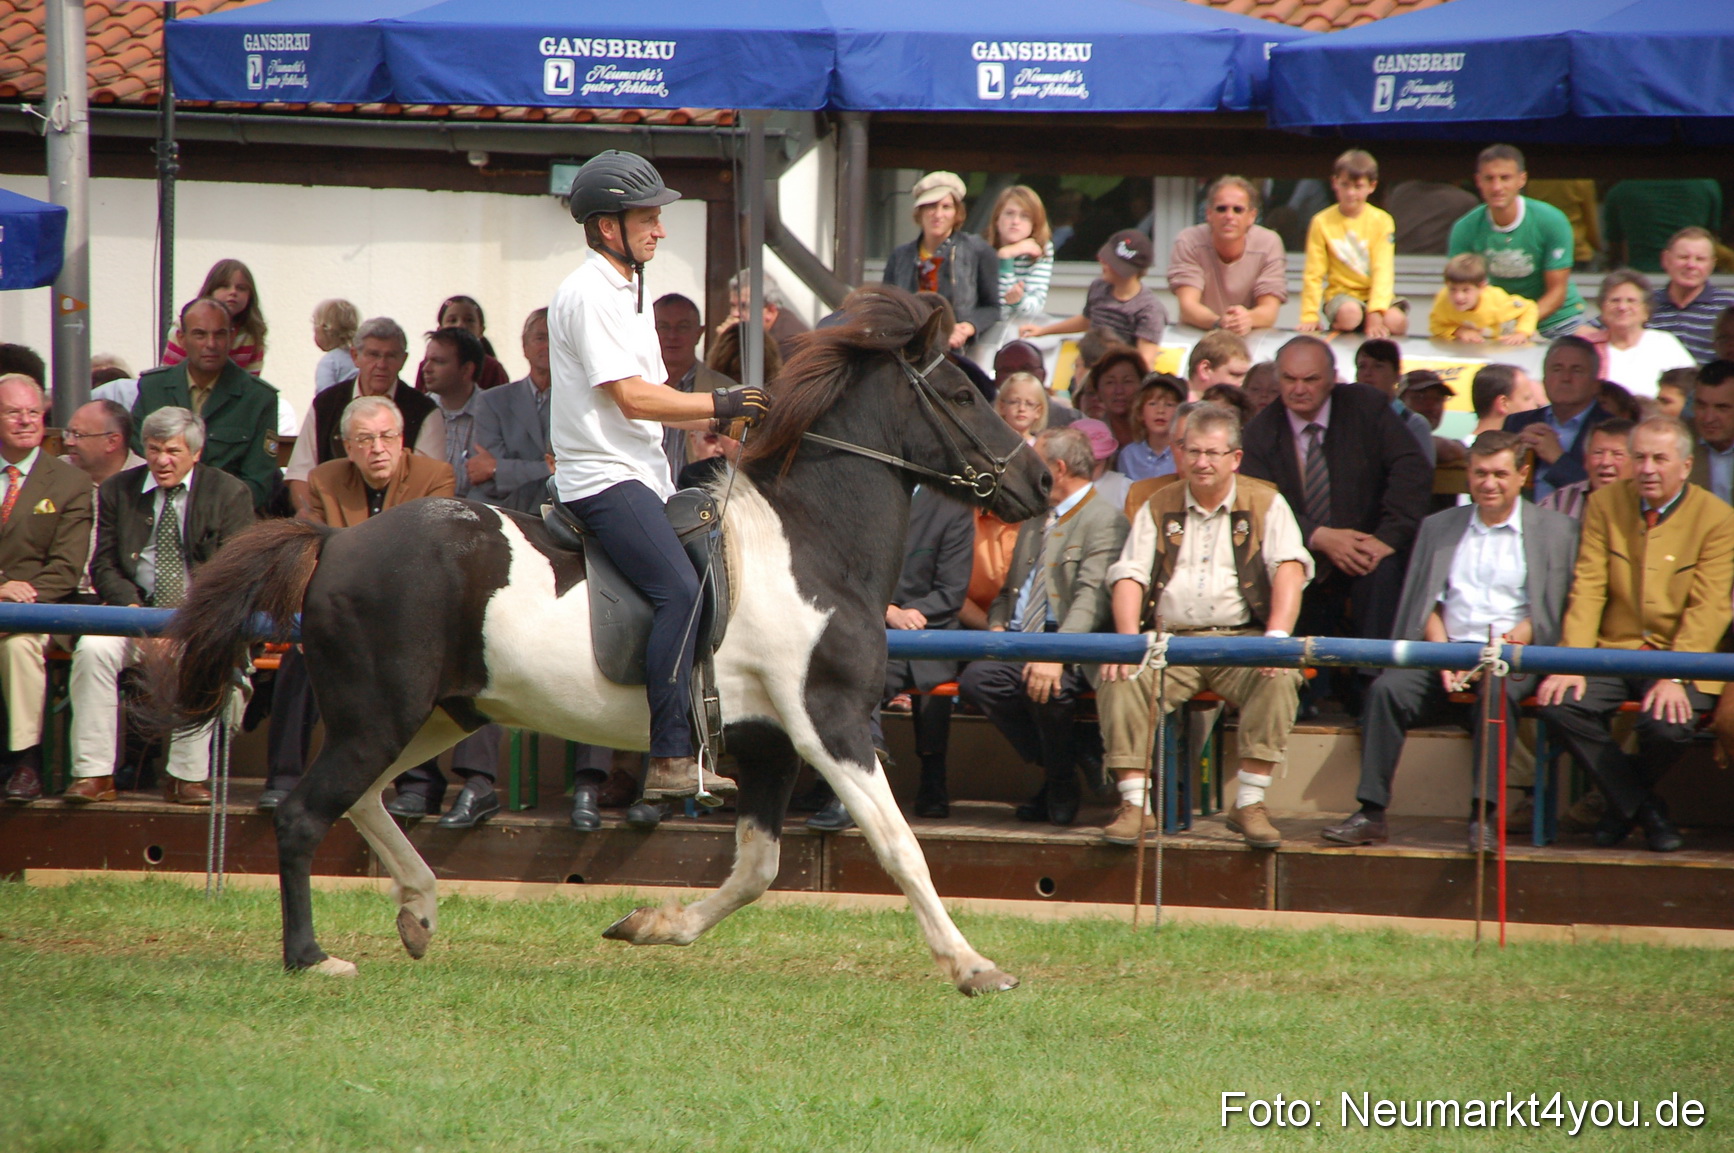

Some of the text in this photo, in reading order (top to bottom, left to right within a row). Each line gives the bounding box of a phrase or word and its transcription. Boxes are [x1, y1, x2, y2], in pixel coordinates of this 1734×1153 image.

[243, 33, 311, 51] GANSBRÄU
[539, 36, 677, 60] GANSBRÄU
[971, 41, 1093, 62] GANSBRÄU
[1373, 52, 1466, 74] GANSBRÄU
[585, 64, 664, 82] Neumarkt's
[1013, 67, 1084, 86] Neumarkt's
[580, 80, 669, 98] guter Schluck
[1010, 85, 1041, 100] guter
